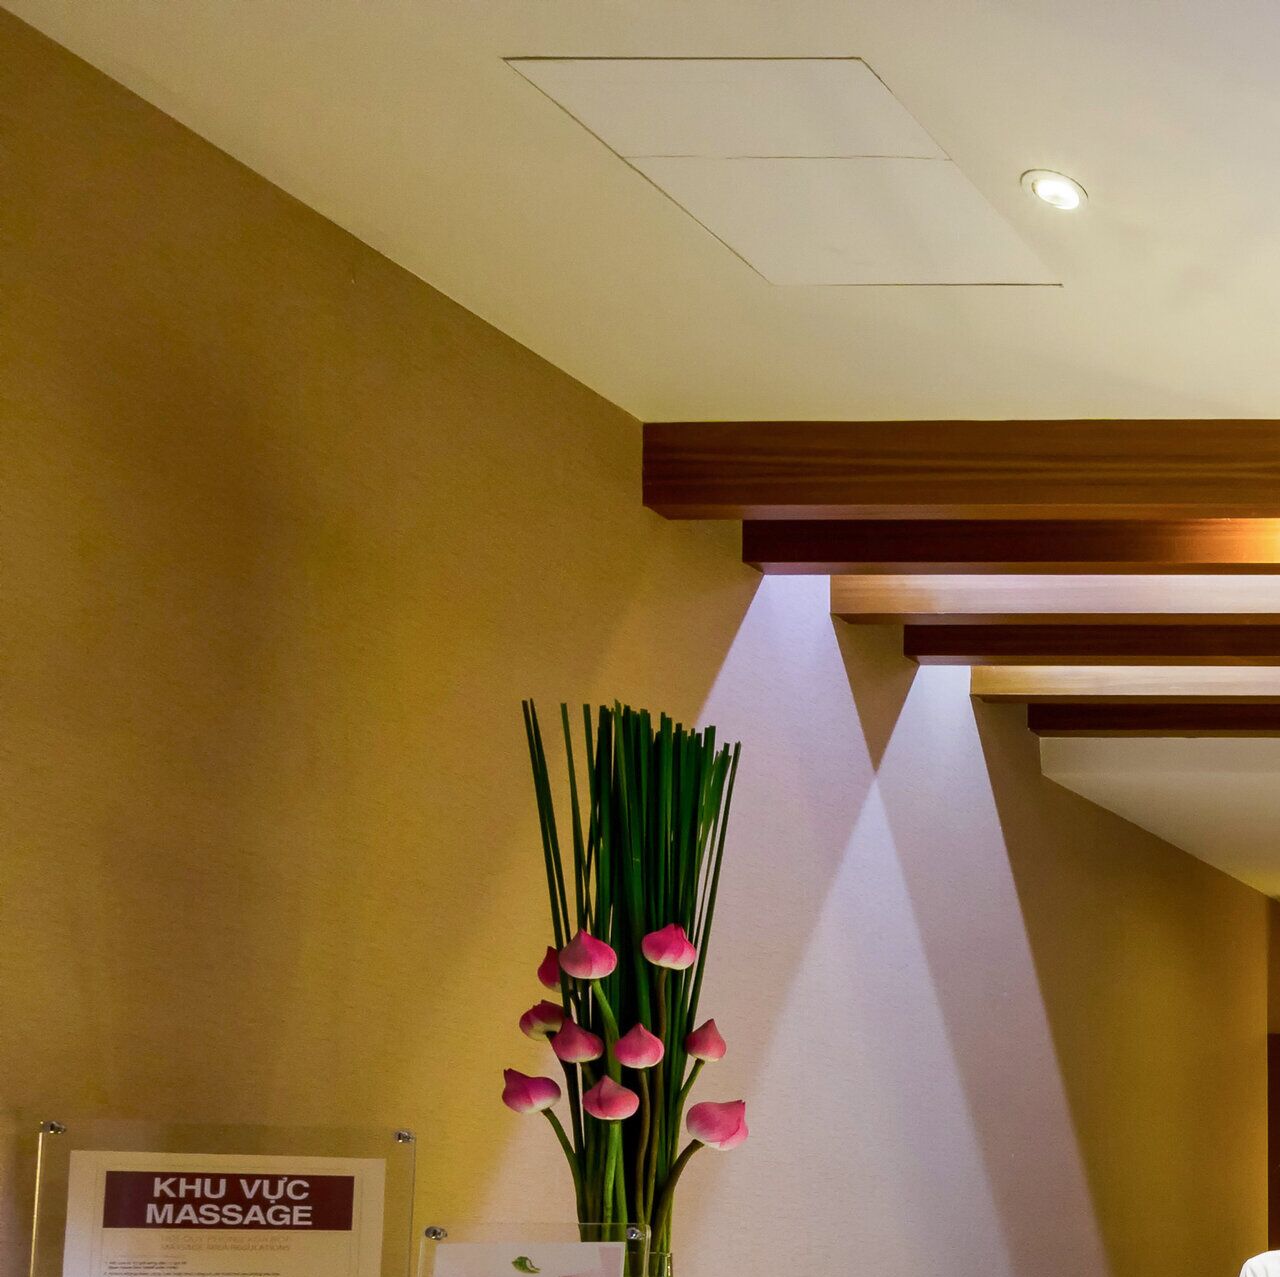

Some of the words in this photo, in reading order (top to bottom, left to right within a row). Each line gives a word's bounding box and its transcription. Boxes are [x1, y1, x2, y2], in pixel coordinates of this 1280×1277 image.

[153, 1177, 227, 1199] KHU
[239, 1176, 311, 1204] VỰC
[145, 1203, 313, 1226] MASSAGE
